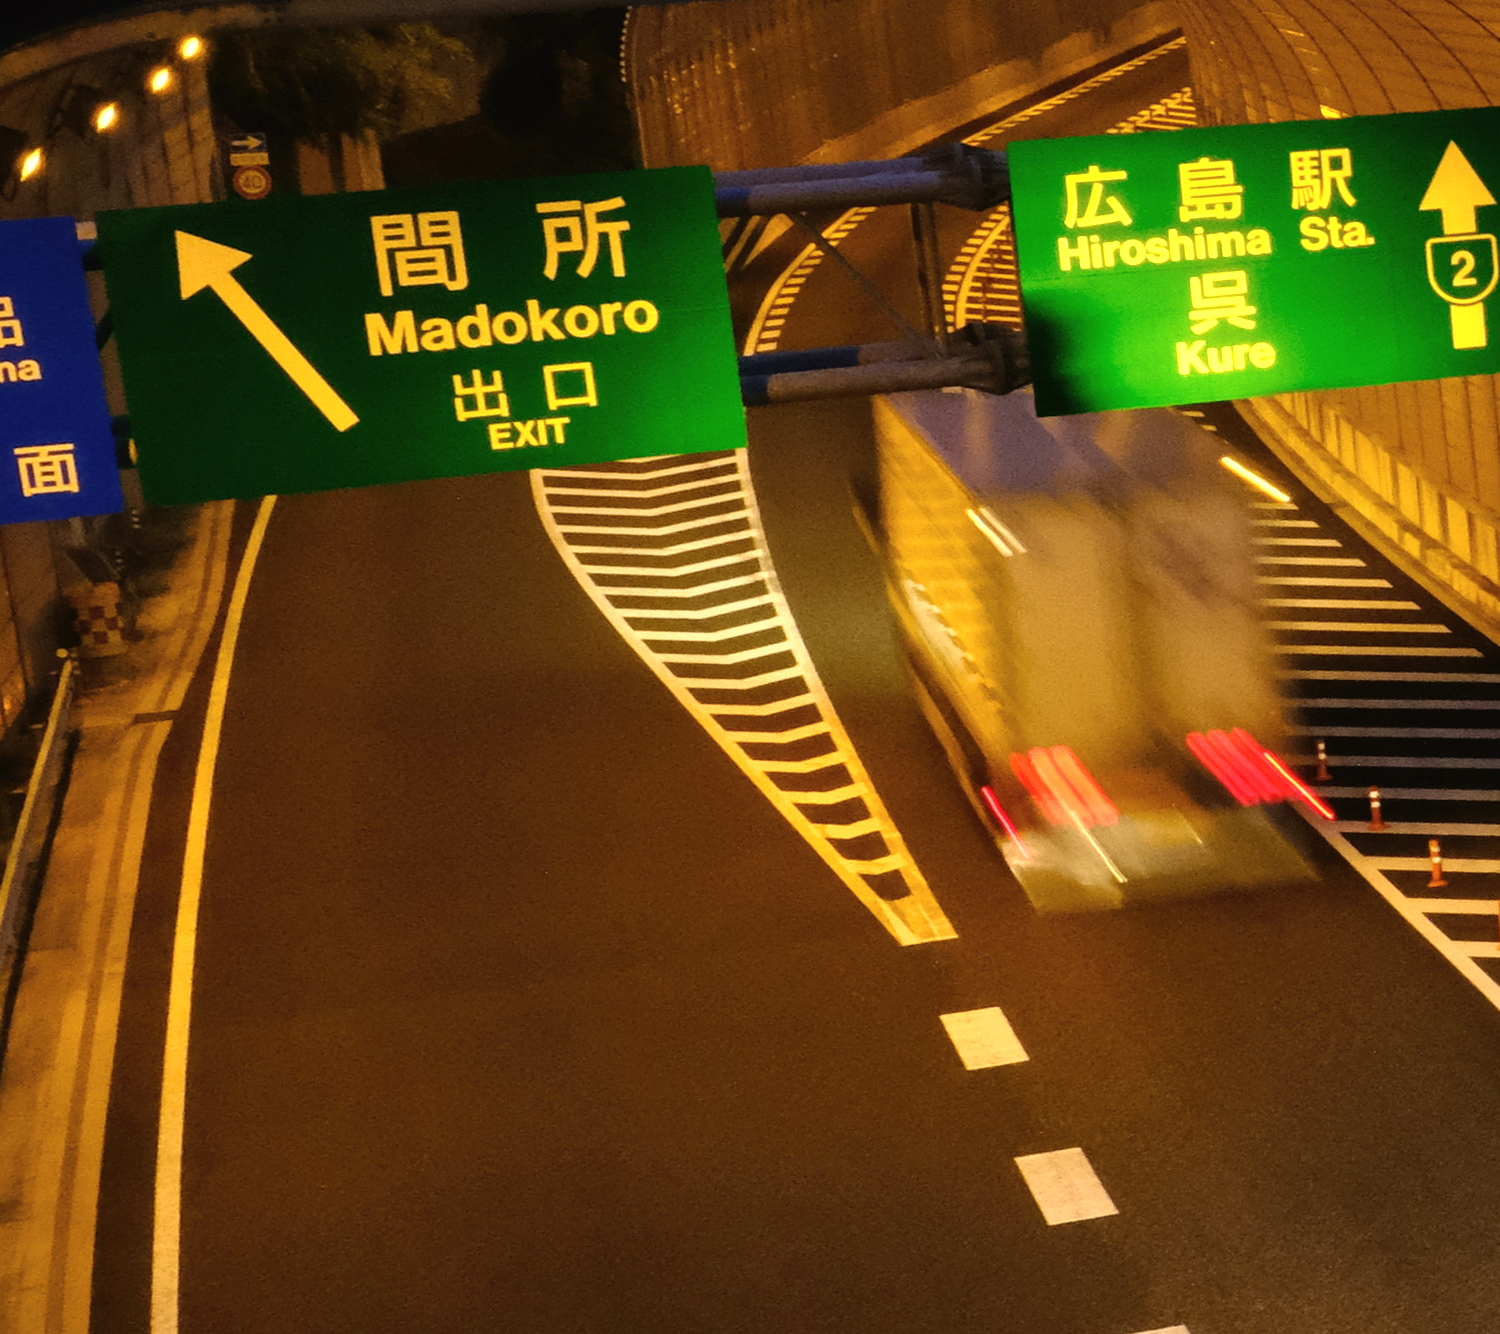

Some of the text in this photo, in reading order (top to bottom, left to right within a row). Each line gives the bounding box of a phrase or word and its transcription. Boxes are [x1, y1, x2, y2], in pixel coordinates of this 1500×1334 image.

[1063, 146, 1357, 229] 広島駅
[370, 196, 631, 297] 間所
[1057, 216, 1376, 272] Hiroshima Sta.
[1450, 250, 1477, 288] 2
[364, 298, 659, 356] Madokoro
[1188, 269, 1256, 335] 呉
[1176, 339, 1277, 376] Kure
[452, 361, 598, 422] 出口
[487, 415, 571, 450] EXIT
